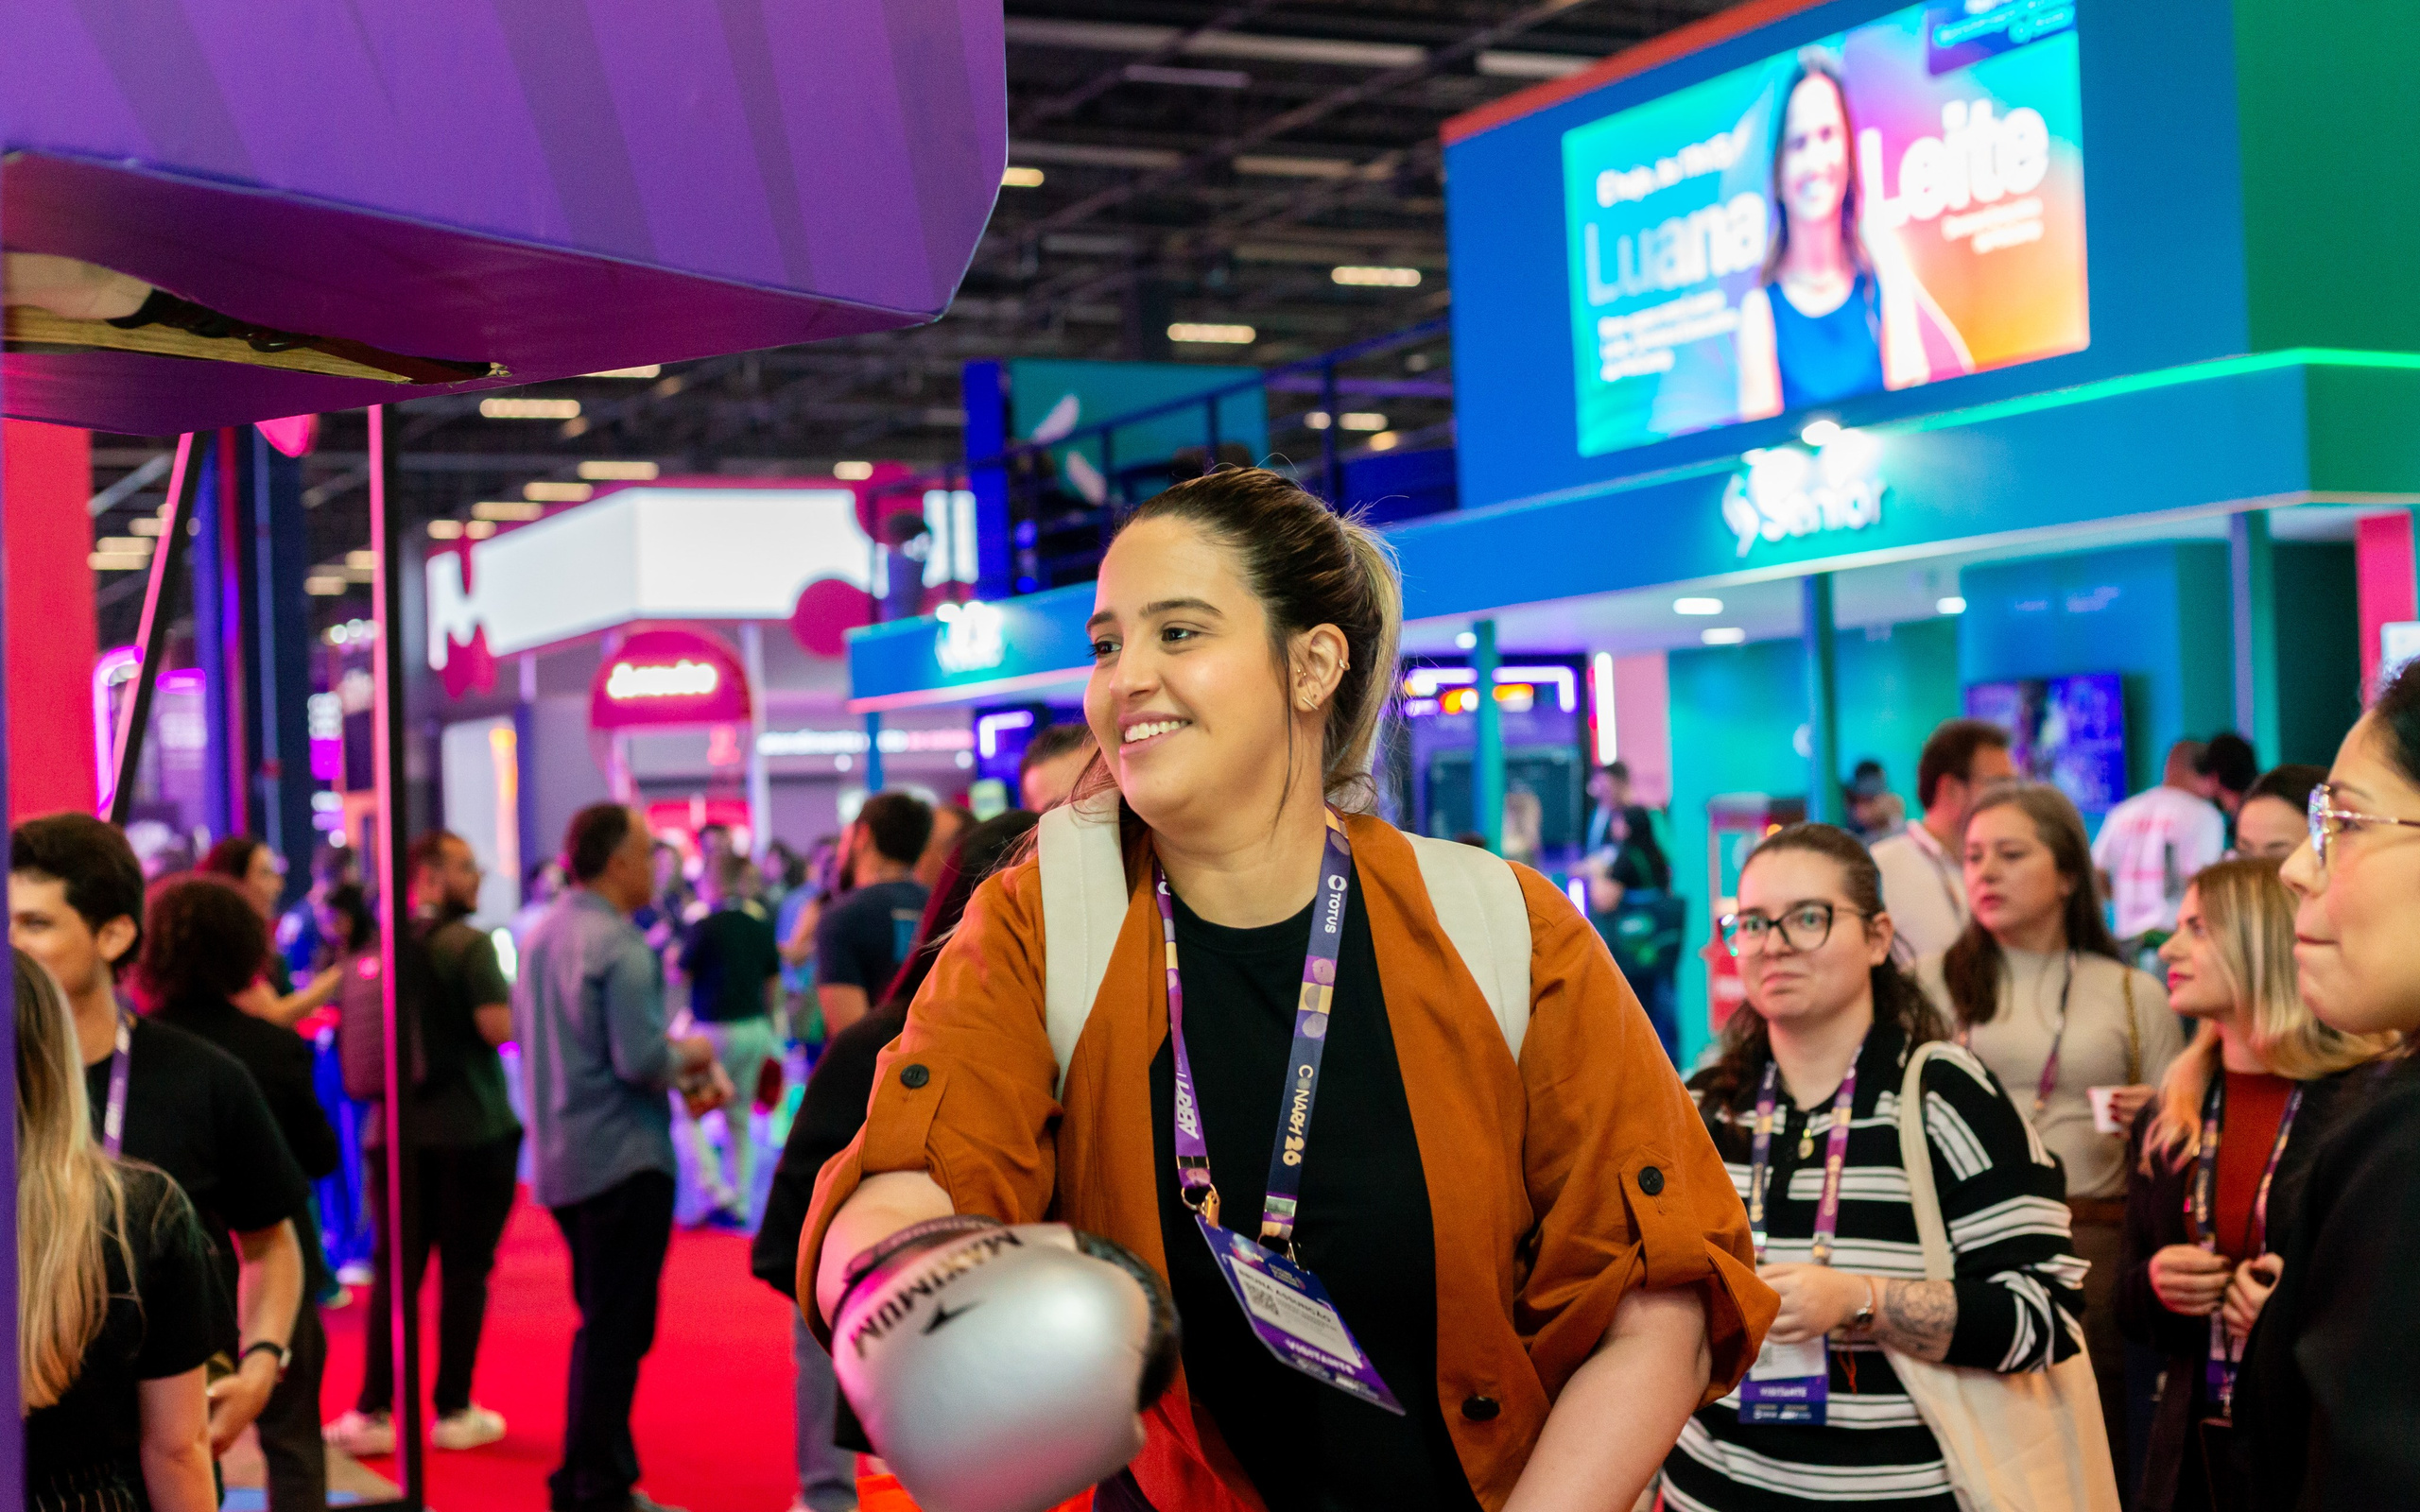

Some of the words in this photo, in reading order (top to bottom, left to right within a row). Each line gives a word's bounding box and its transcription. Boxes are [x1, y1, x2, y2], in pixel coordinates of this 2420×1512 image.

[1585, 192, 1768, 306] Luana
[1859, 98, 2049, 228] Leite
[850, 1228, 1025, 1359] MAXIMUM
